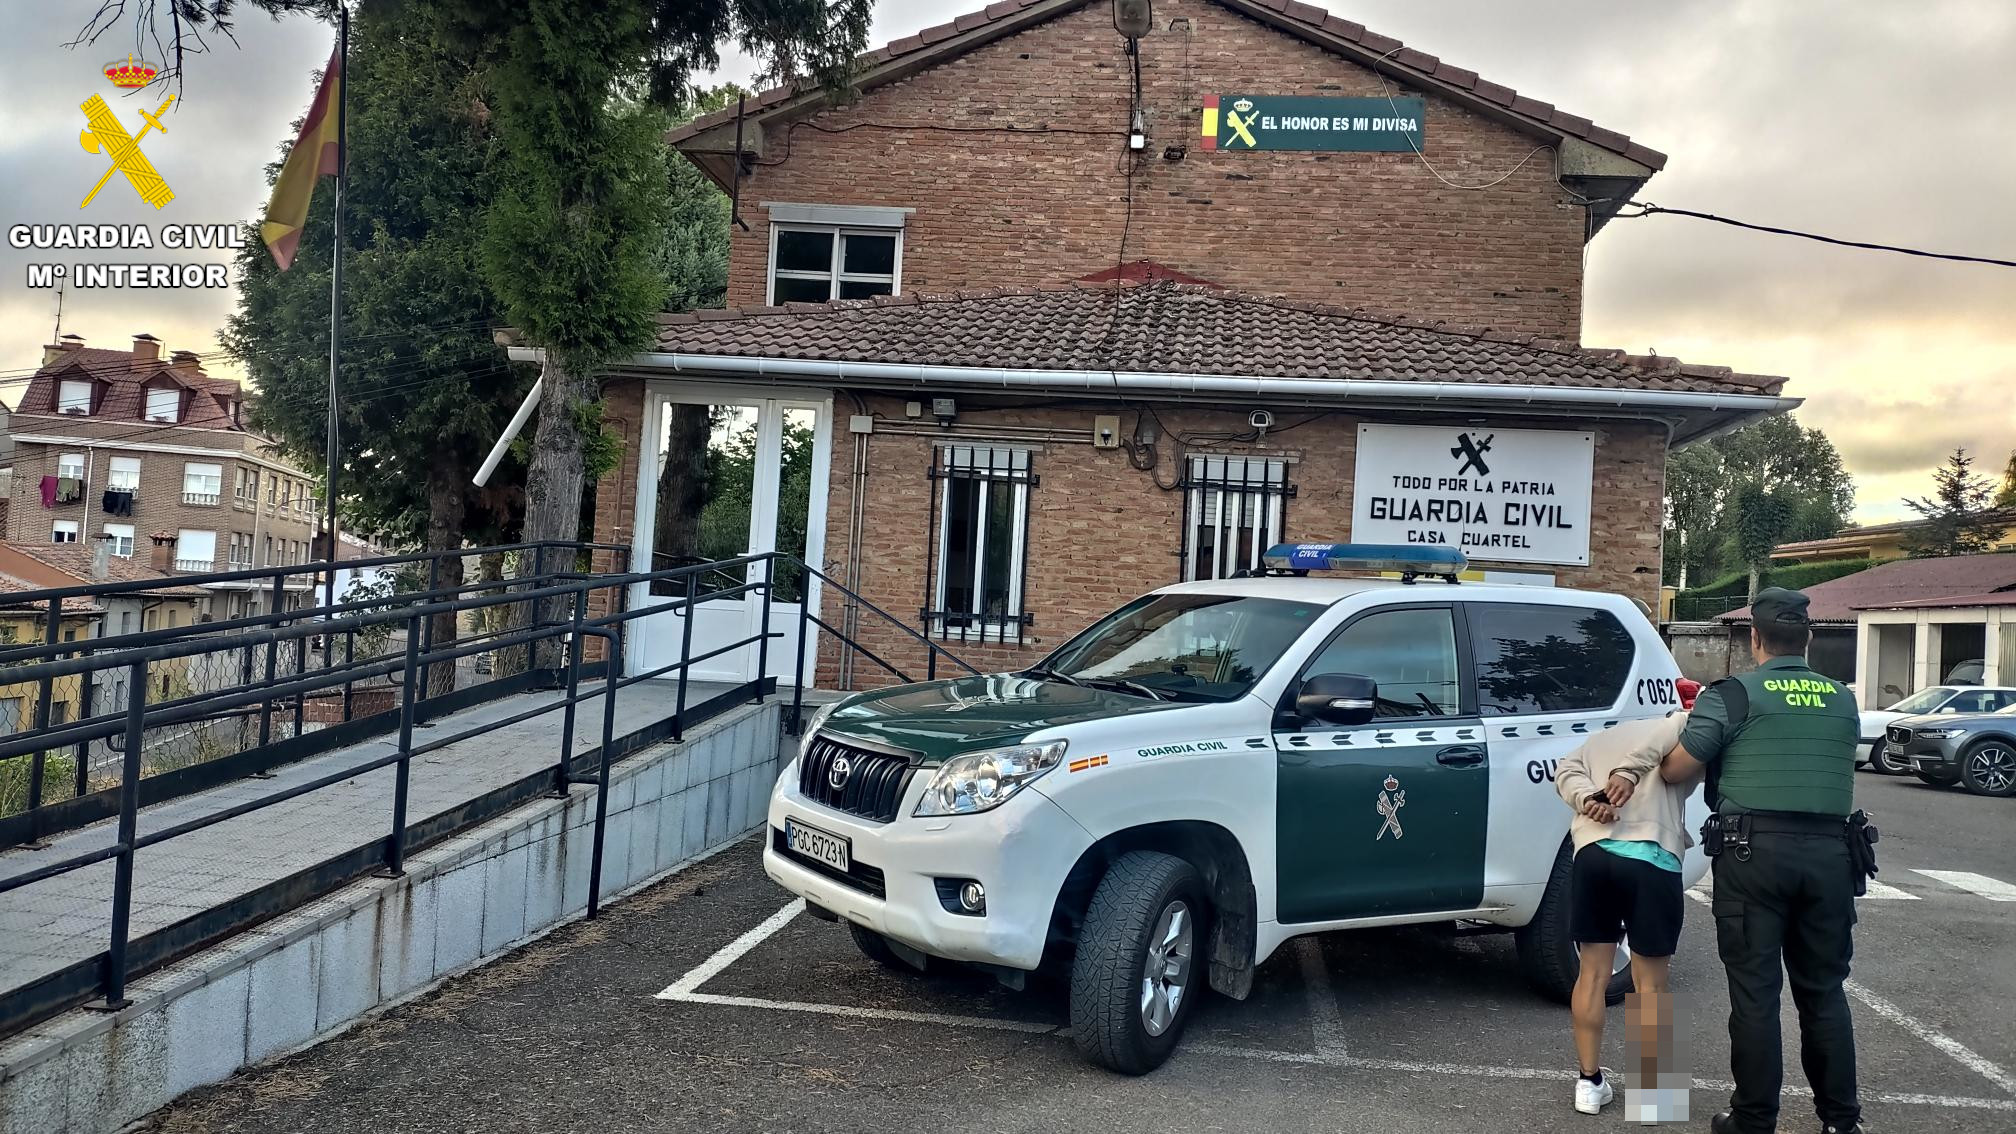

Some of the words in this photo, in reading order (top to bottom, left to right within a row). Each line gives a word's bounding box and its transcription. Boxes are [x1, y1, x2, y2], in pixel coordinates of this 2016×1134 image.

[1261, 116, 1277, 130] EL
[1281, 116, 1329, 131] HONOR
[1332, 117, 1350, 131] ES
[1353, 117, 1369, 131] MI
[1372, 117, 1418, 131] DIVISA
[1392, 475, 1431, 490] TODO
[1438, 478, 1468, 492] POR
[1474, 479, 1494, 493] LA
[1502, 481, 1555, 496] PATRIA
[1370, 497, 1488, 524] GUARDIA
[1504, 502, 1573, 528] CIVIL
[1407, 530, 1446, 544] CASA
[1461, 532, 1531, 549] CUARTEL
[1298, 550, 1320, 558] CIVIL
[1647, 678, 1677, 705] 062
[1764, 679, 1838, 694] GUARDIA
[1785, 693, 1827, 708] CIVIL
[1137, 743, 1196, 758] GUARDIA
[1197, 741, 1228, 752] CIVIL
[791, 826, 811, 852] PGC
